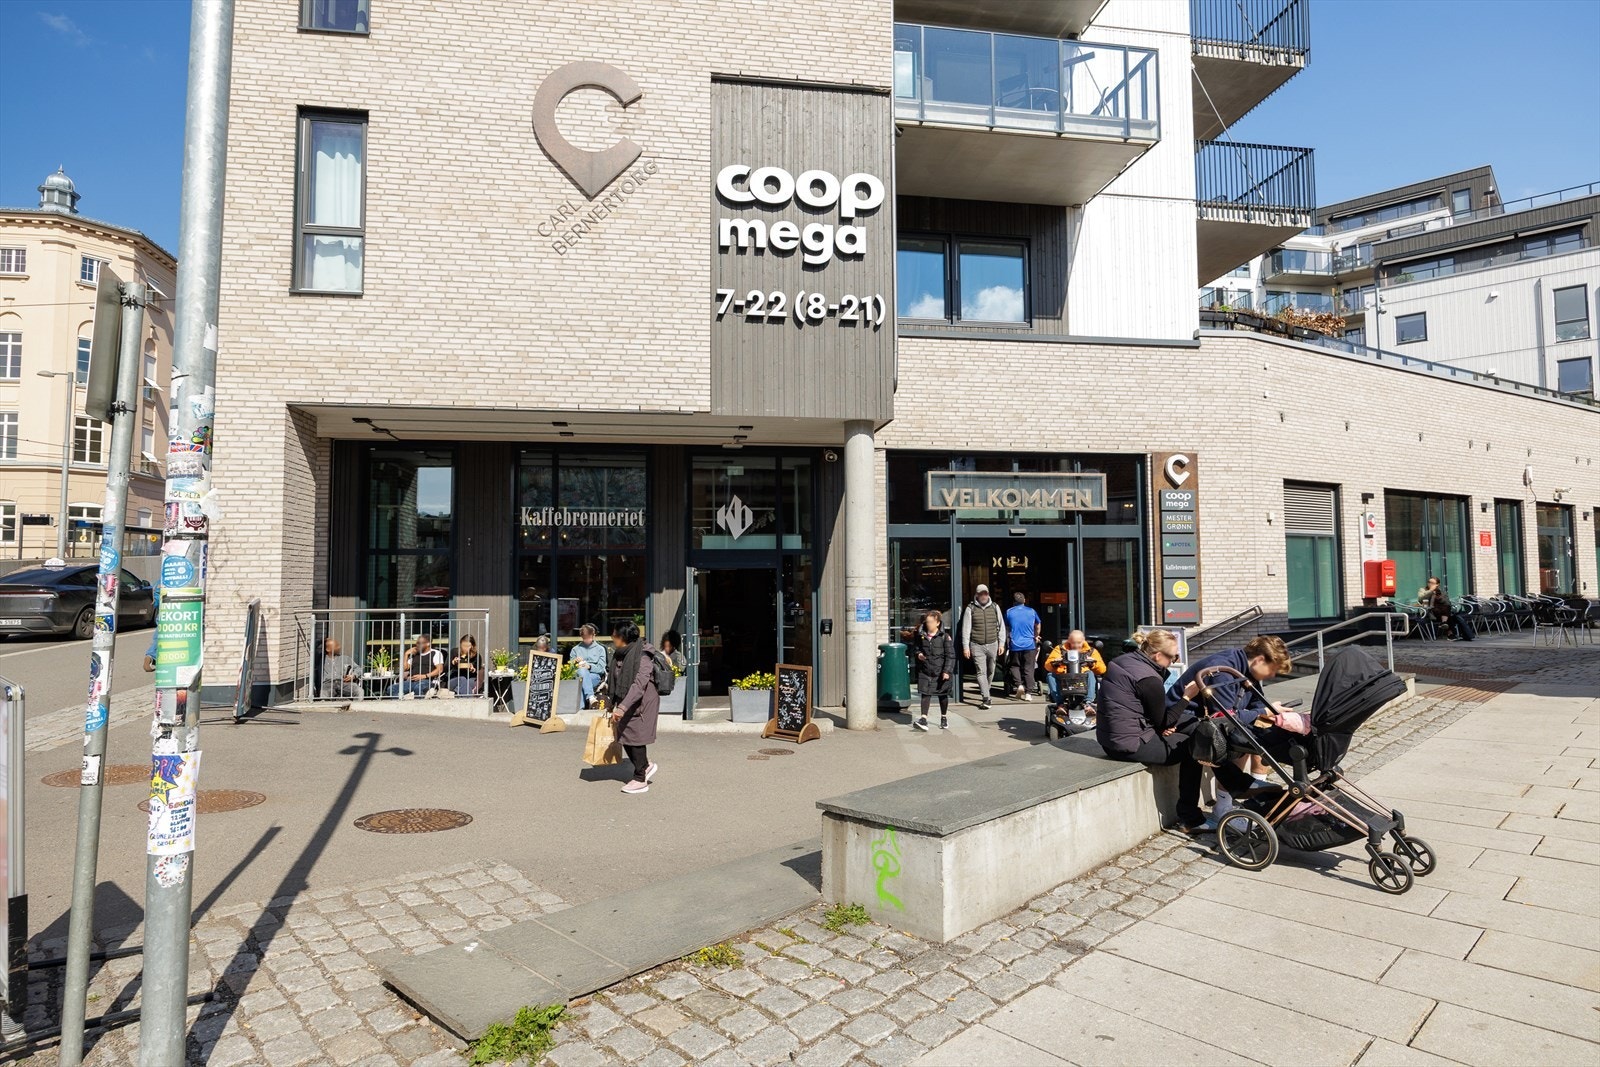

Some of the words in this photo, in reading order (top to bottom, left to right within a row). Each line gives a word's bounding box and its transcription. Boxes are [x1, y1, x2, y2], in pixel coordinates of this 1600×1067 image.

[716, 164, 885, 218] coop
[537, 199, 584, 239] CARL
[719, 217, 867, 265] mega
[716, 288, 788, 317] 7-22
[794, 289, 887, 326] (8-21)
[940, 487, 1093, 508] VELKOMMEN
[1165, 492, 1192, 501] coop
[1165, 501, 1189, 509] mega
[520, 506, 646, 527] Kaffebrenneriet
[1166, 514, 1192, 522] MESTER
[158, 610, 199, 621] EKORT
[184, 622, 198, 632] KR
